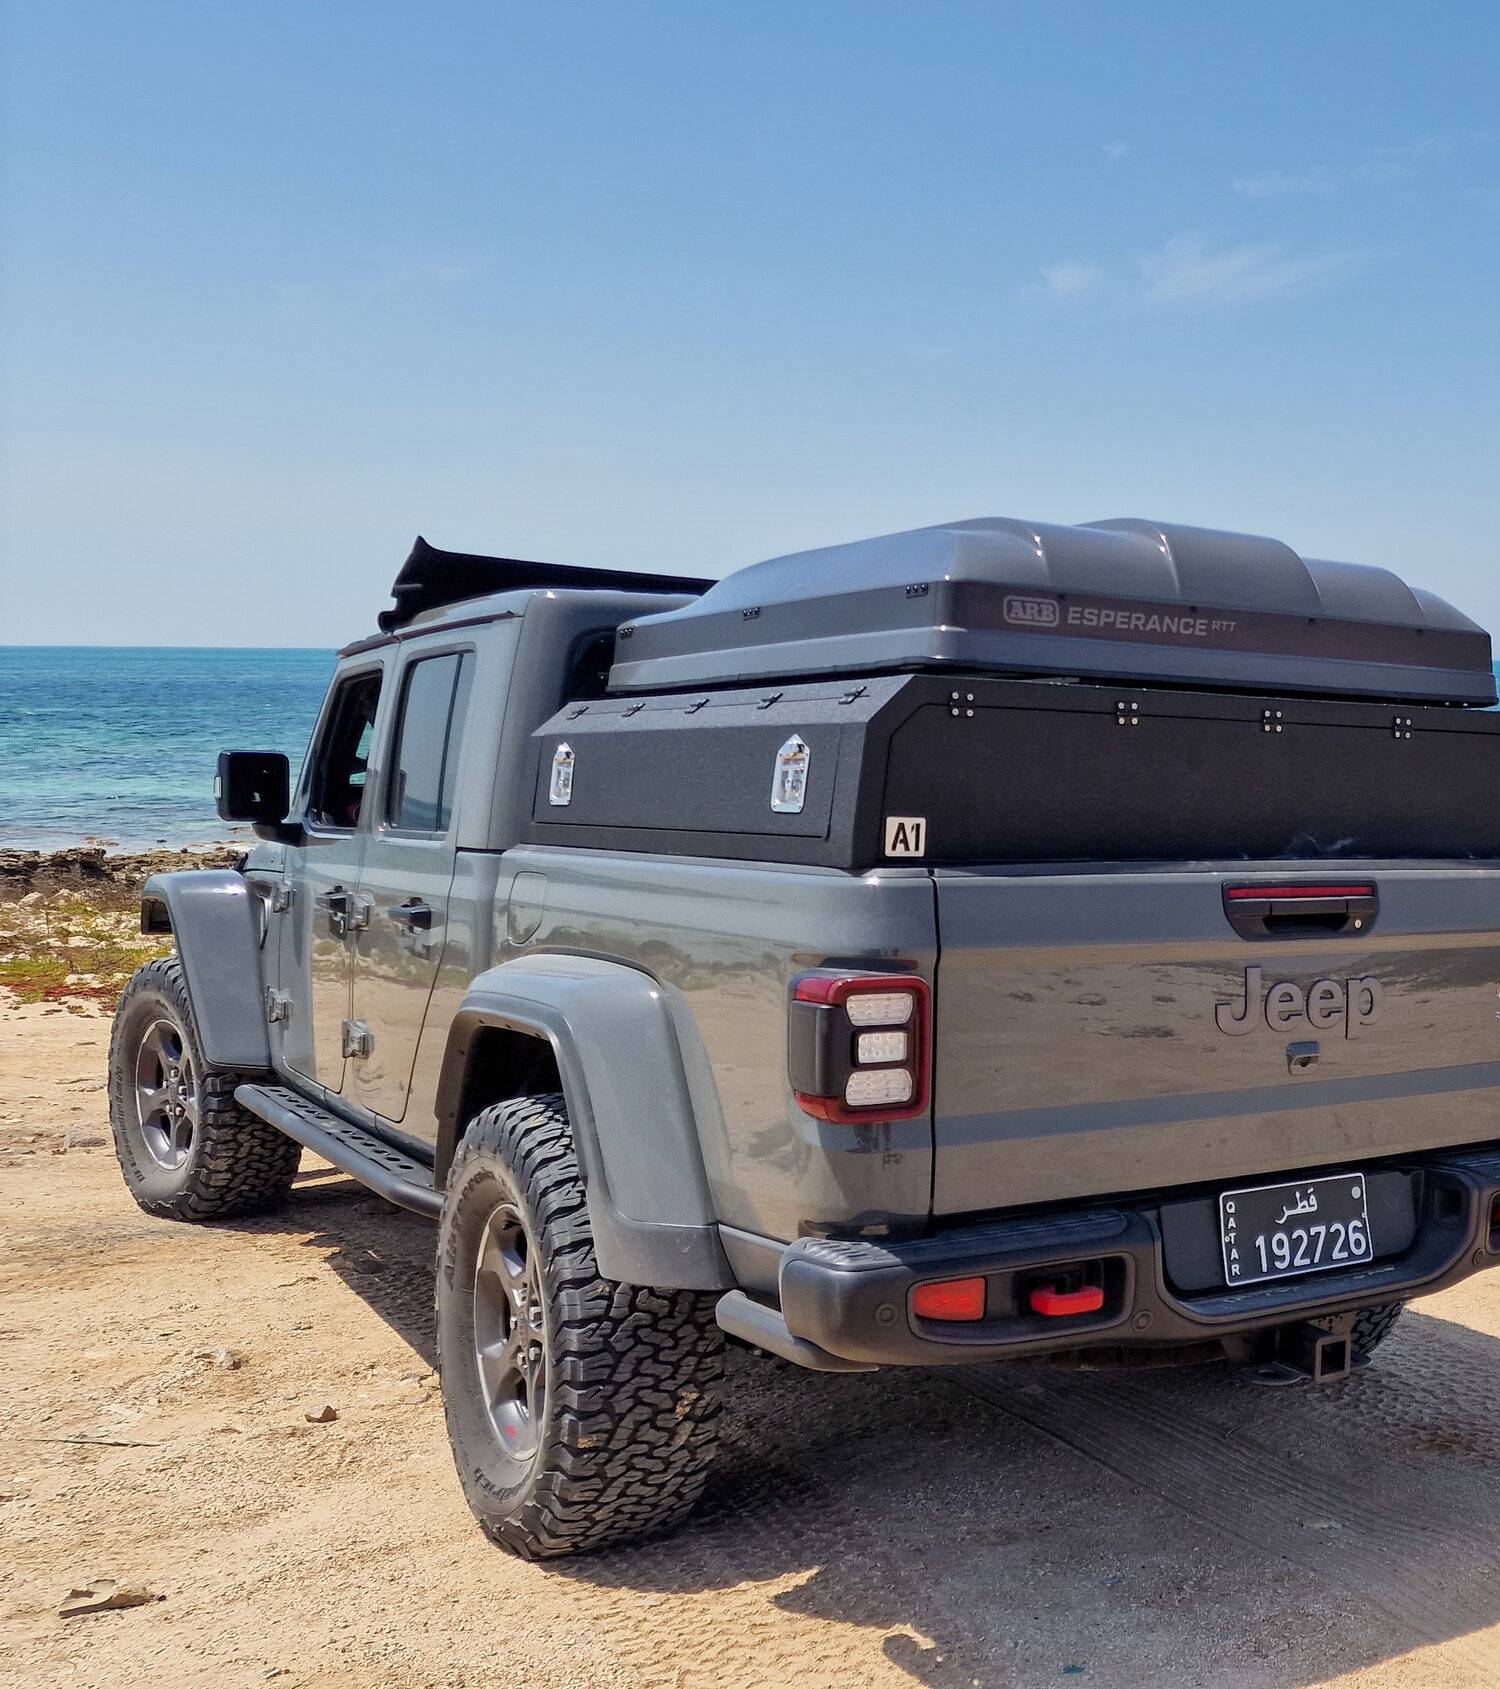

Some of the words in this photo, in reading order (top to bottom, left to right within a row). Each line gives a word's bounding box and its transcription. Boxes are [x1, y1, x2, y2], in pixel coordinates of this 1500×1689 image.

[1007, 600, 1056, 623] ARB
[1067, 606, 1209, 637] ESPERANCE
[1211, 620, 1238, 632] RTT
[890, 822, 921, 852] A1
[1214, 965, 1384, 1041] Jeep
[1274, 1187, 1318, 1225] قطر
[1225, 1201, 1241, 1277] QATAR
[1255, 1219, 1367, 1273] 192726
